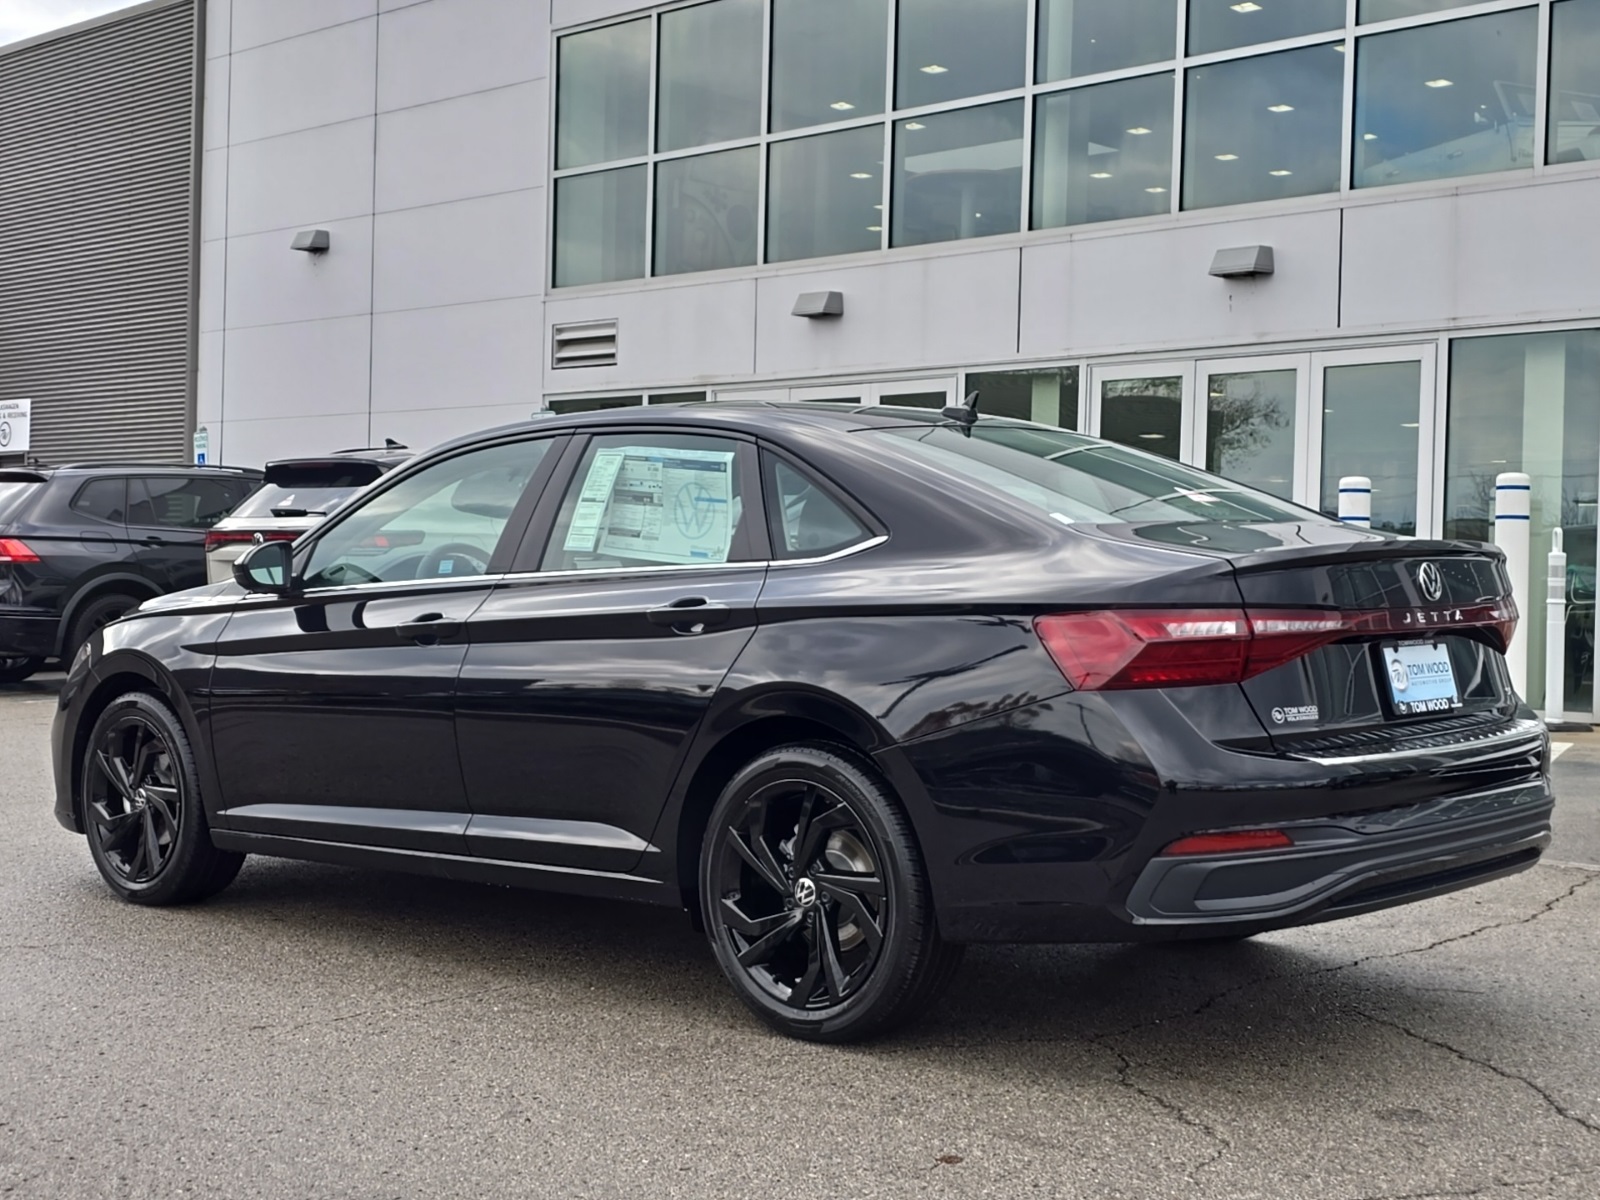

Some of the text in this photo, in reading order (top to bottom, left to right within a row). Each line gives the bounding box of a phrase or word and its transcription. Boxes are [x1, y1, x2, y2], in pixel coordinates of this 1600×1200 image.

[1403, 609, 1463, 624] JETTA
[1407, 661, 1449, 676] TOM WOOD
[1283, 705, 1318, 715] TOM WOOD
[1410, 698, 1449, 713] TOM WOOD
